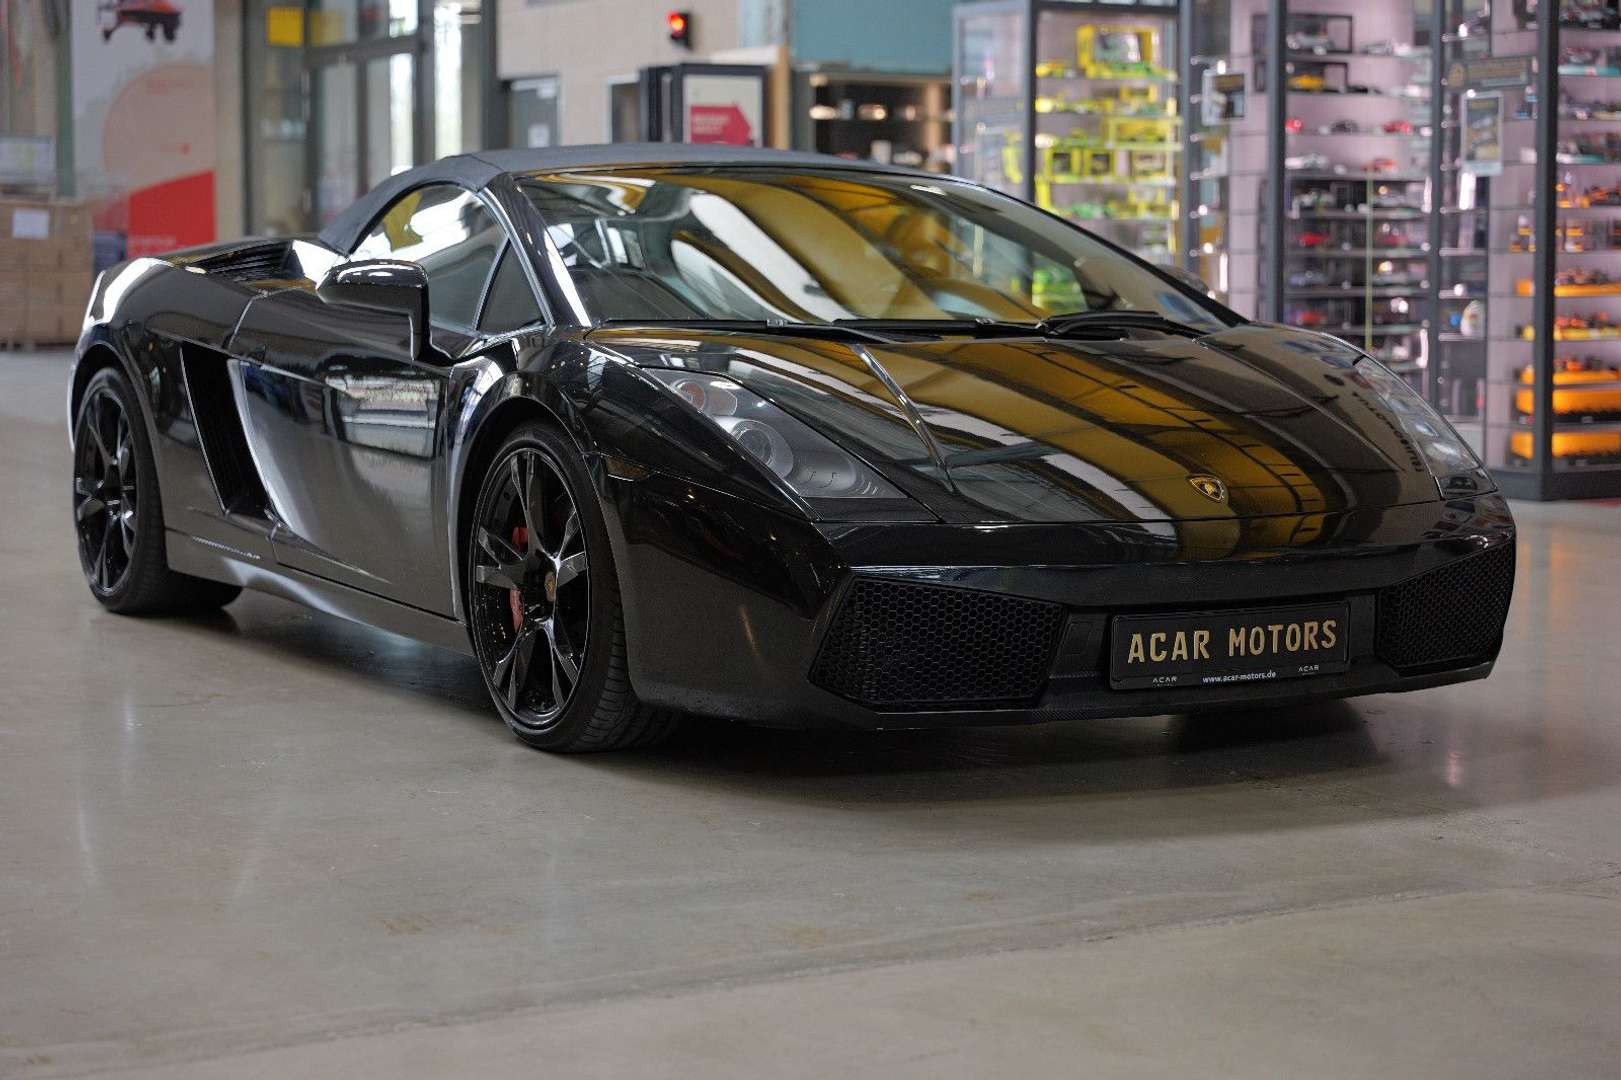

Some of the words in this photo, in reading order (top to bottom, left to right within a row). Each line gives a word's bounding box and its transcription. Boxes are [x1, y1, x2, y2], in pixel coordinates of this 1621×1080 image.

[1127, 629, 1211, 664] ACAR
[1228, 619, 1337, 657] MOTORS
[1297, 664, 1319, 673] ACAR
[1152, 676, 1178, 684] ACAR
[1202, 669, 1277, 684] www.acar-motors.de
